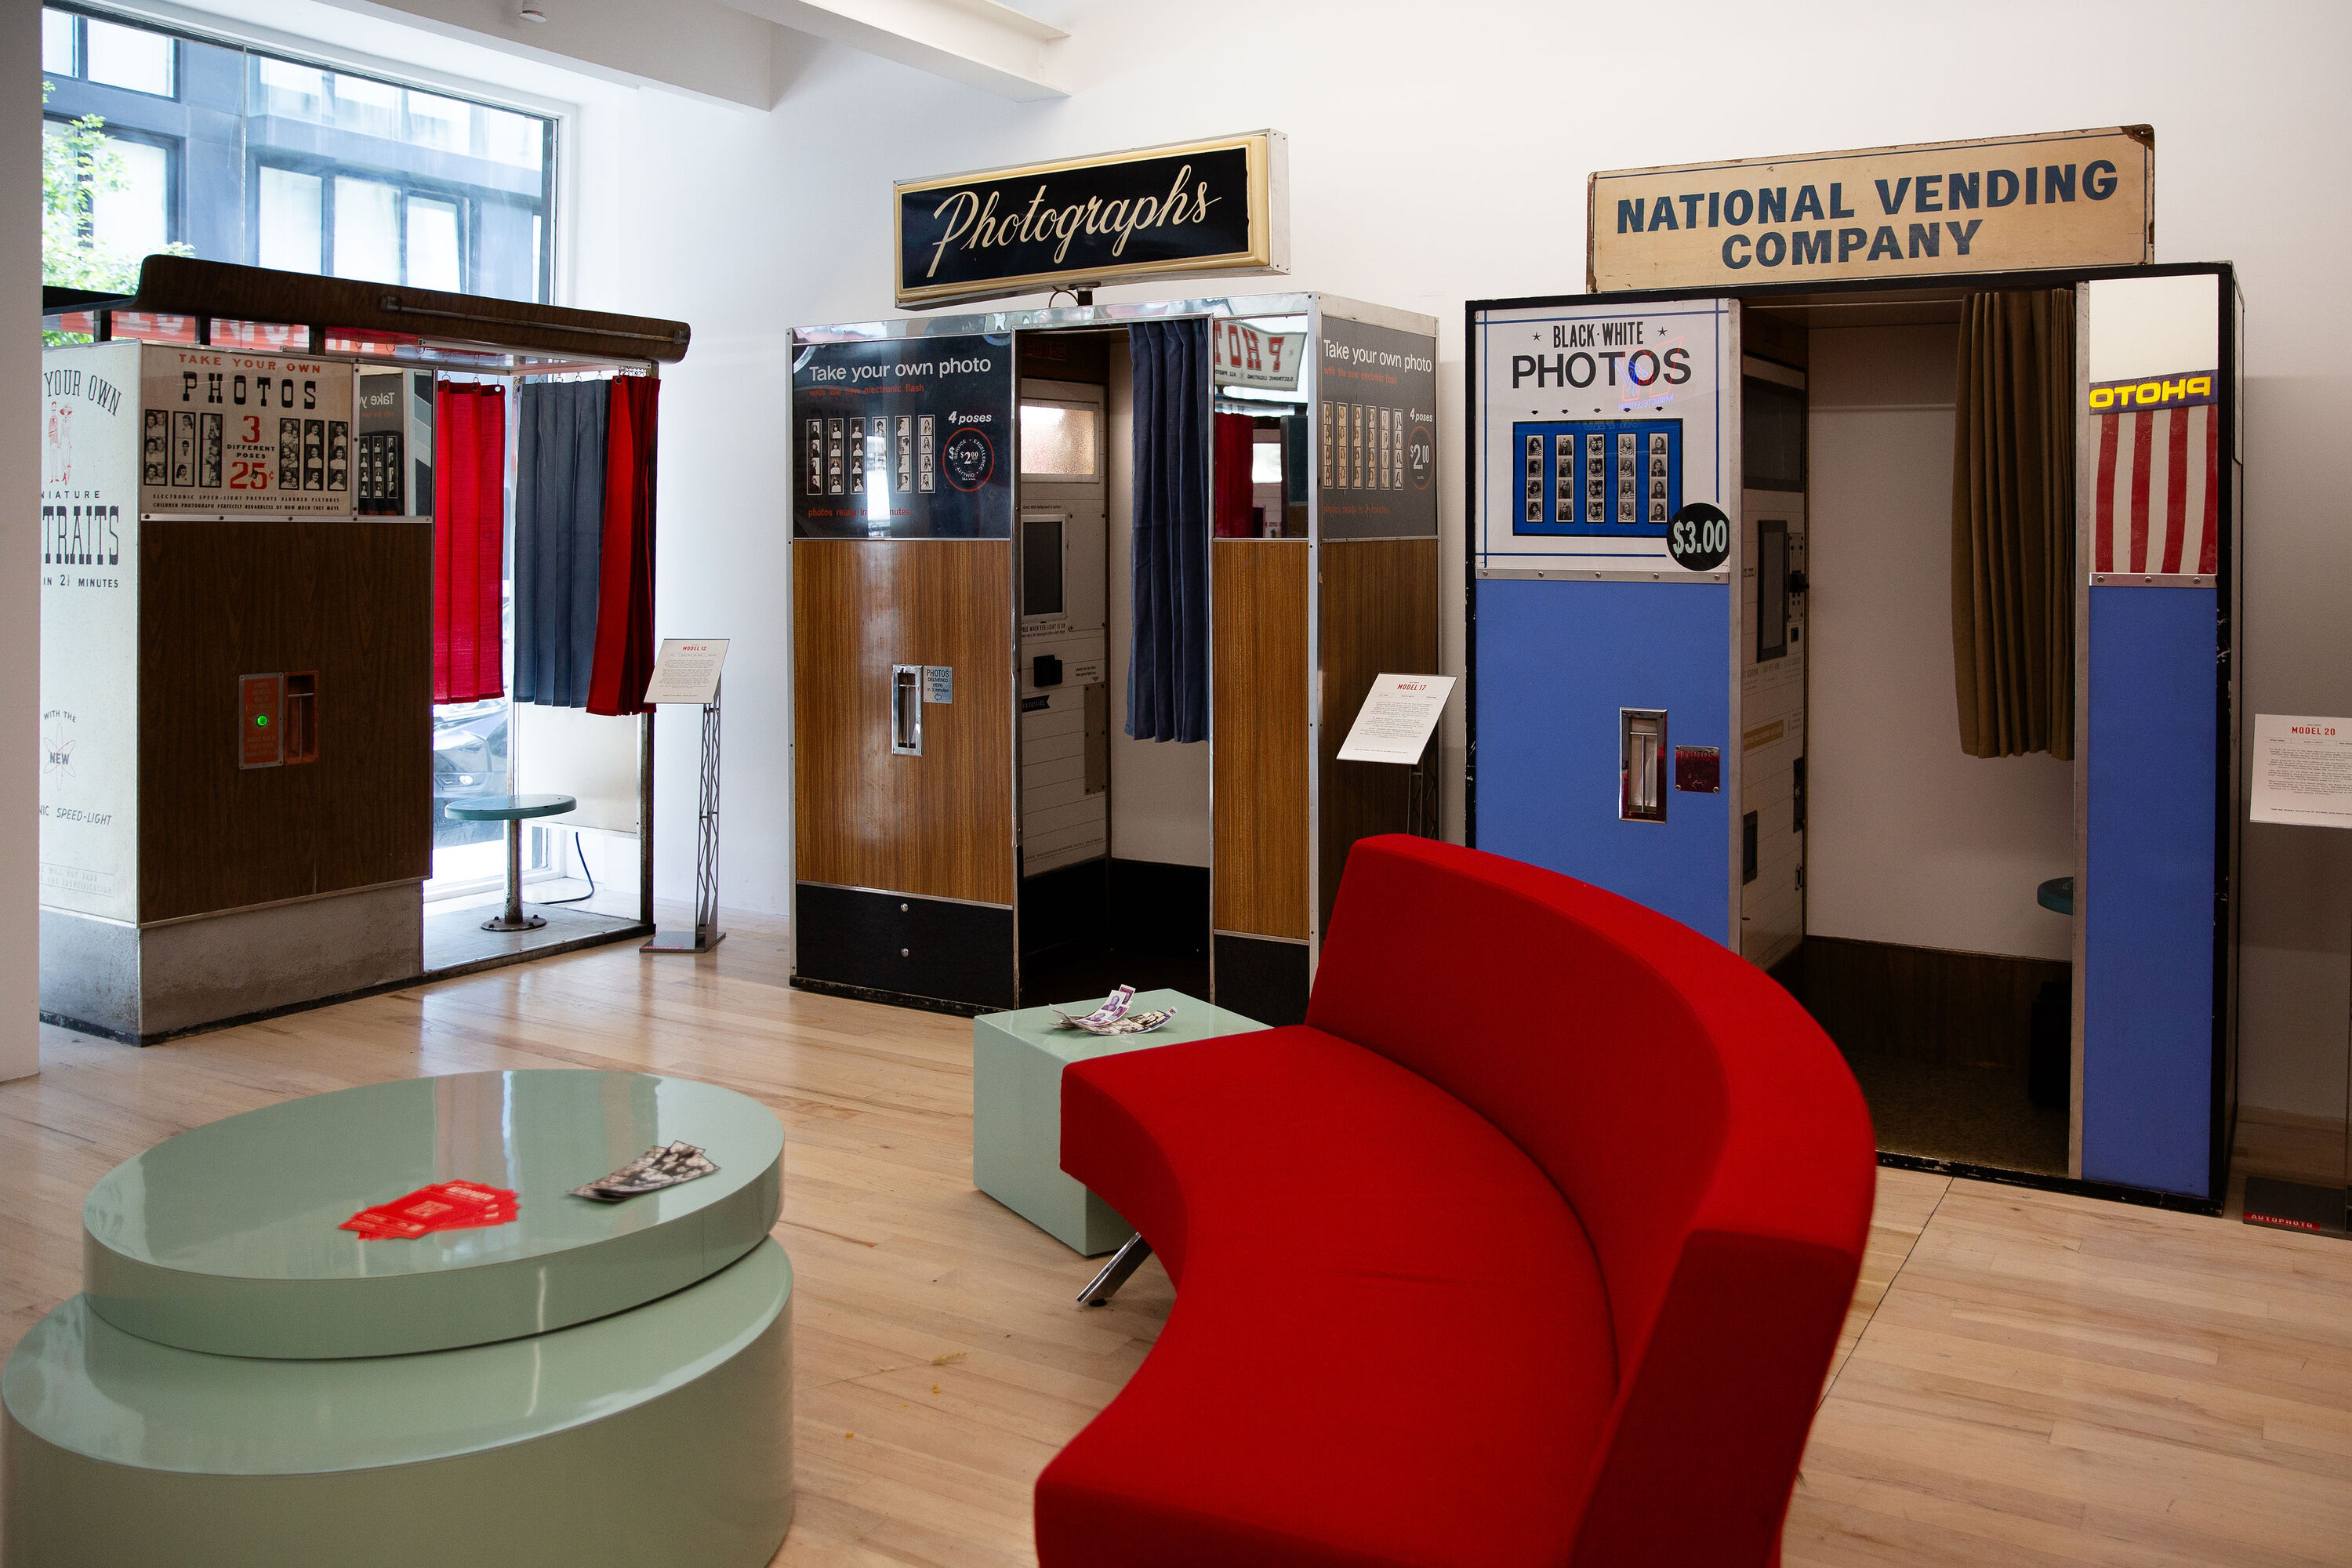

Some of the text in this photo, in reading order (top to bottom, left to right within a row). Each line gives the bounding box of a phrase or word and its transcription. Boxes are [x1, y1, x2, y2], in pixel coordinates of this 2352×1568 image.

[1617, 159, 2118, 234] NATIONAL VENDING
[927, 165, 1222, 278] Photographs
[1722, 219, 1984, 270] COMPANY
[179, 354, 320, 373] TAKE YOUR OWN
[1323, 339, 1432, 372] Take your own photo
[809, 358, 991, 383] Take your own photo
[1512, 347, 1691, 388] PHOTOS
[44, 370, 122, 416] YOUR OWN
[183, 371, 316, 409] PHOTOS
[905, 383, 924, 393] flash
[948, 411, 992, 425] 4 poses
[1410, 408, 1433, 423] 4 poses
[242, 416, 260, 443] 3
[973, 439, 986, 471] EXCELLENCE
[808, 507, 833, 517] photos
[836, 508, 857, 517] ready
[889, 508, 910, 517] nutes
[42, 506, 119, 565] TRAITS
[1672, 519, 1726, 558] $3.00
[43, 577, 53, 586] IN
[78, 579, 119, 588] MINUTES
[927, 669, 949, 678] PHOTOS
[43, 710, 77, 723] WITH THE
[2292, 726, 2321, 735] MODEL
[49, 752, 70, 766] NEW
[1680, 750, 1715, 760] PHOTOS
[56, 808, 112, 826] SPEED-LIGHT
[2251, 1214, 2313, 1228] AUTOPHOTO
